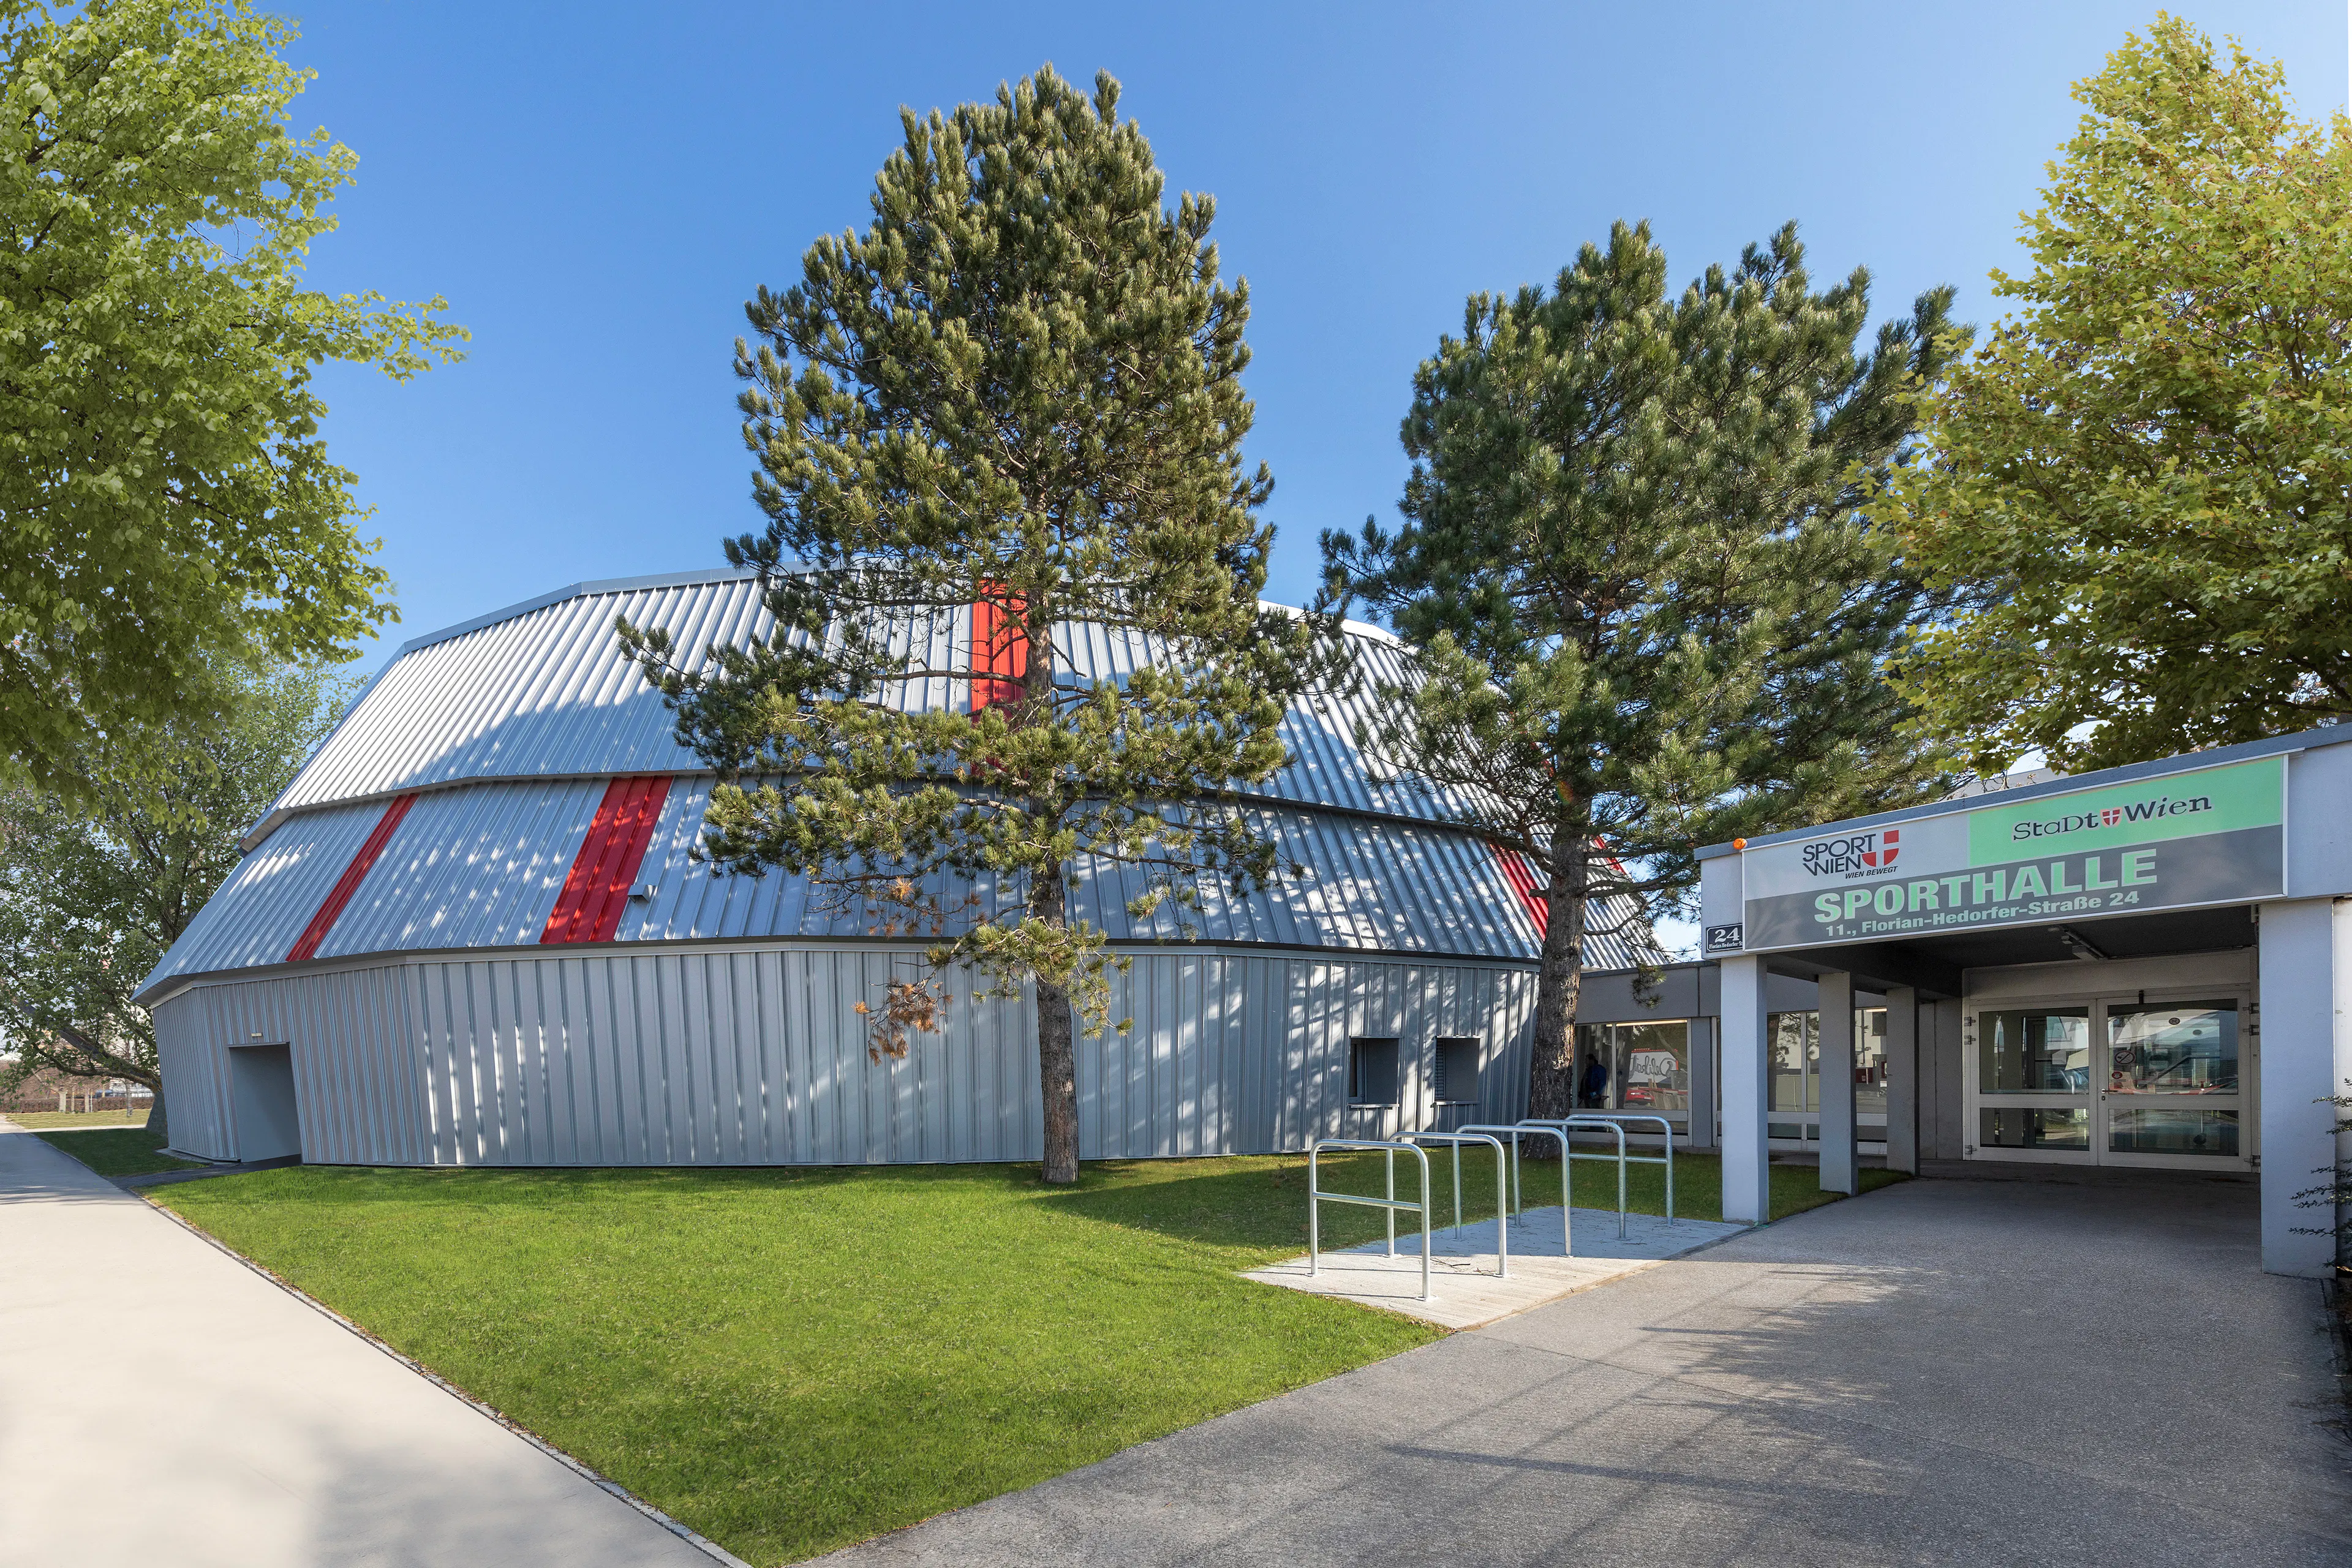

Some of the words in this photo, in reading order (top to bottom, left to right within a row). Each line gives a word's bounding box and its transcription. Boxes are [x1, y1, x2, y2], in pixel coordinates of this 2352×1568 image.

[2124, 797, 2212, 821] Wien
[1803, 834, 1876, 862] SPORT
[1803, 854, 1861, 876] WIEN
[1866, 866, 1898, 876] BEWEGT
[1814, 848, 2157, 923] SPORTHALLE
[1826, 924, 1856, 937] 11.,
[1862, 896, 2101, 933] Florian-Hedorfer-Straße
[2109, 891, 2139, 907] 24
[1714, 927, 1740, 943] 24
